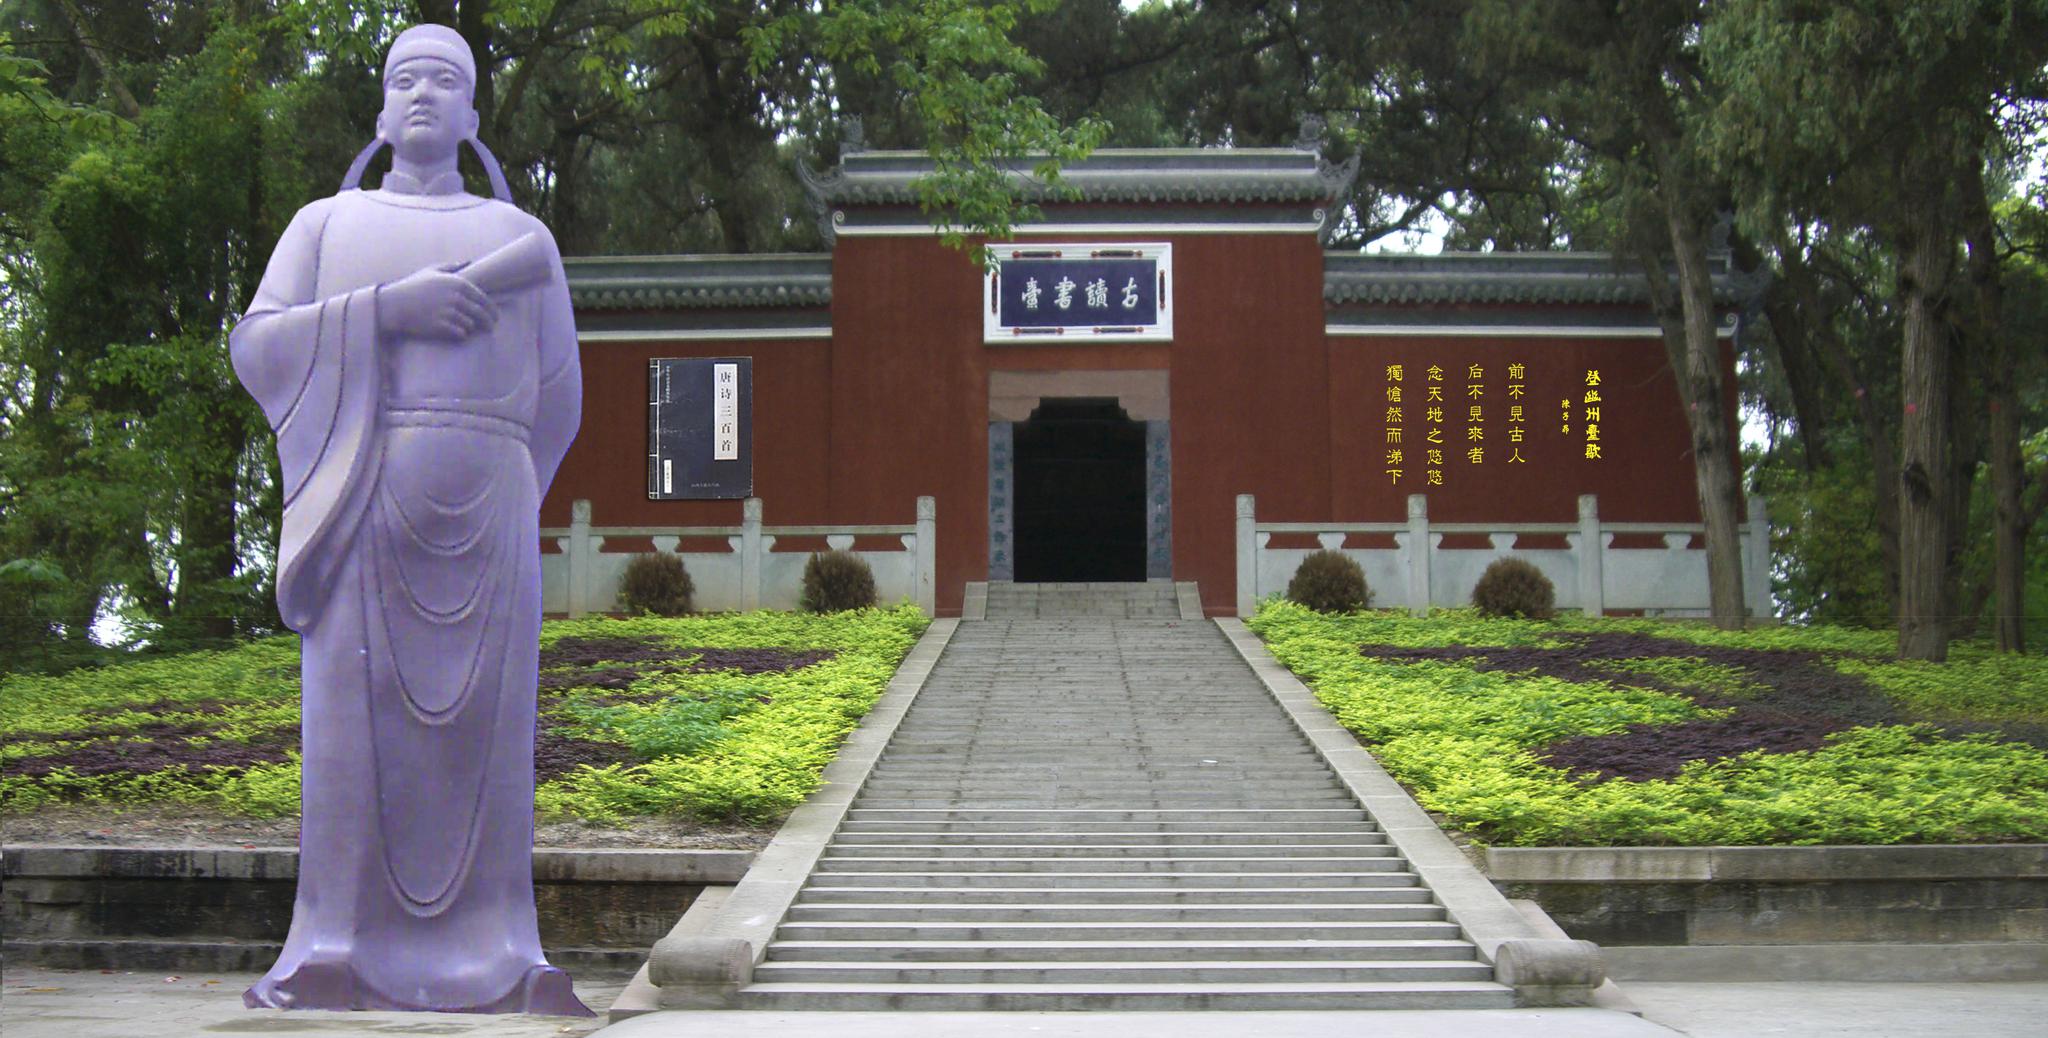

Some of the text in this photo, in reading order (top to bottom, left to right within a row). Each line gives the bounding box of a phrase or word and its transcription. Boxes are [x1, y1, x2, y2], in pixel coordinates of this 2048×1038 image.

[720, 371, 732, 452] 唐诗三百首
